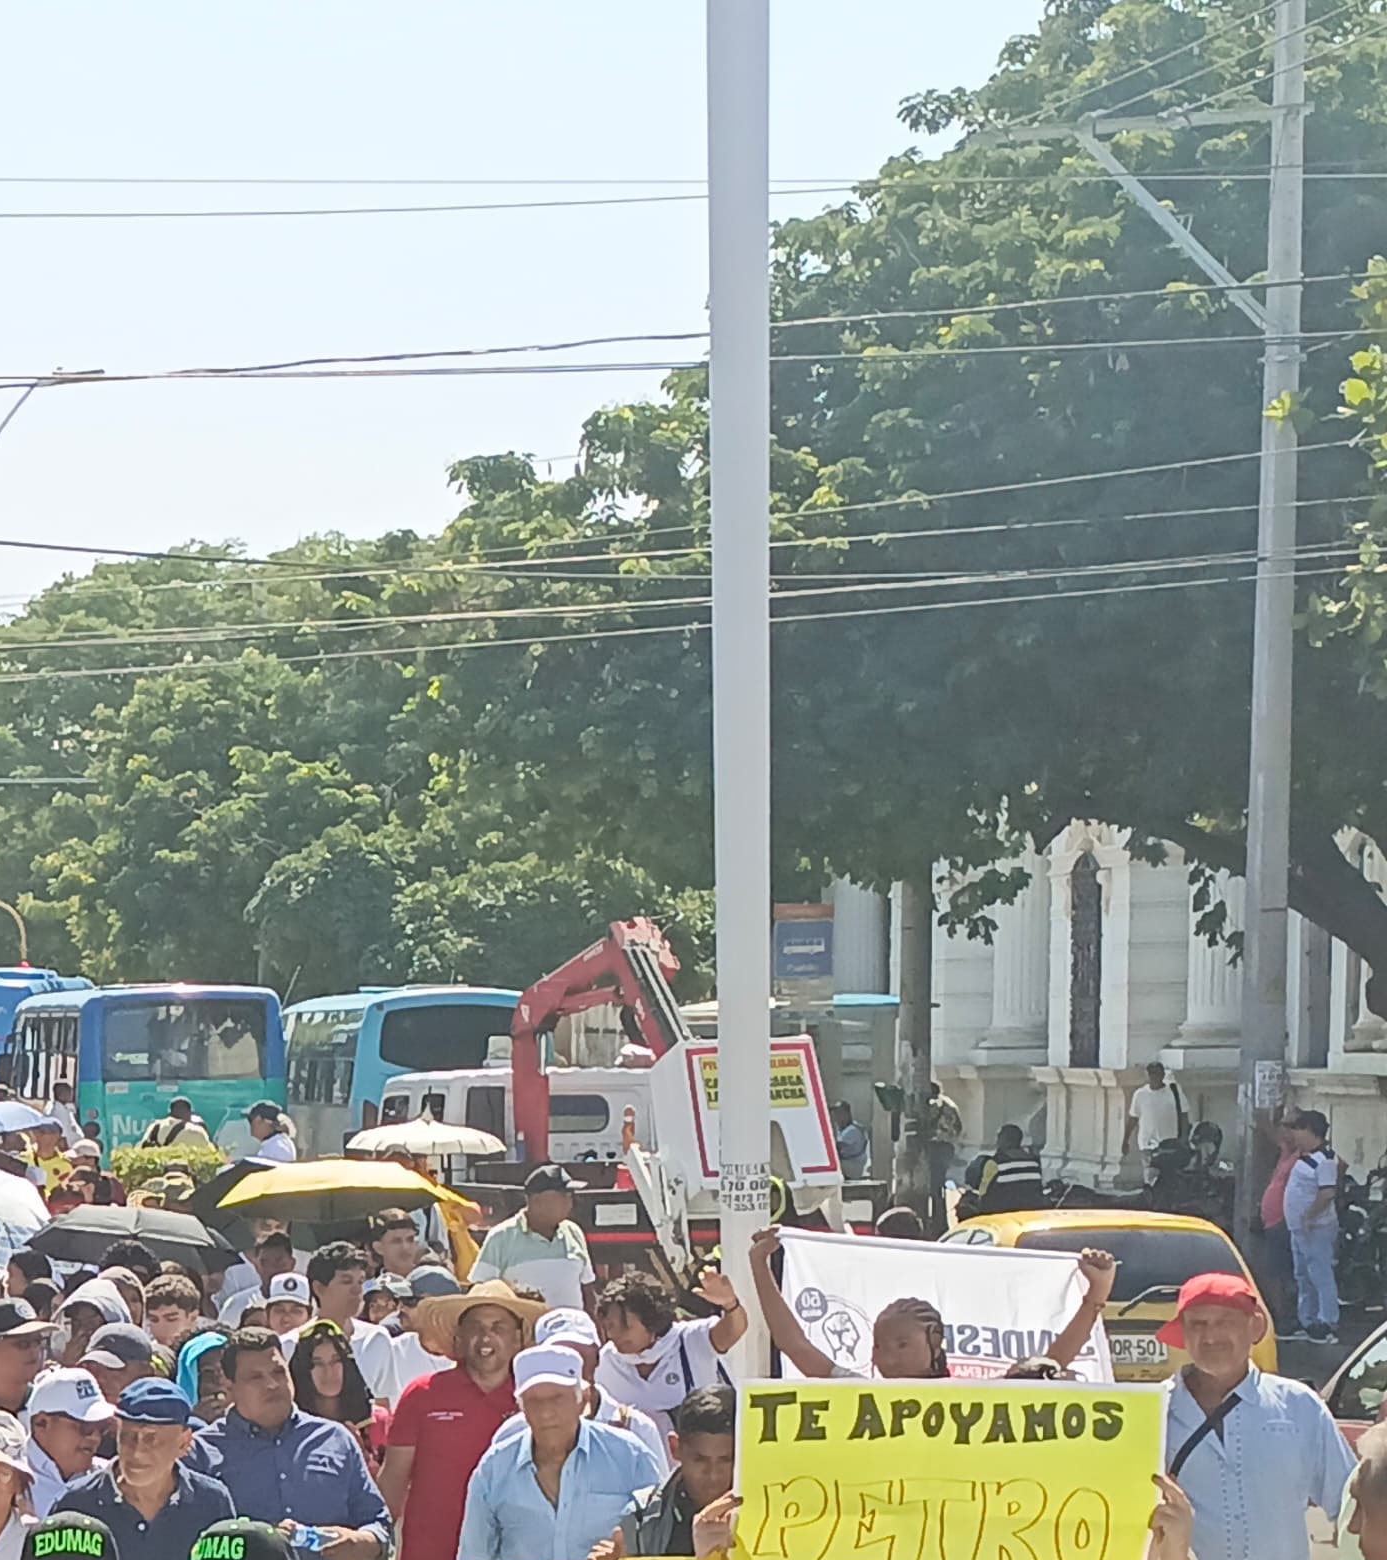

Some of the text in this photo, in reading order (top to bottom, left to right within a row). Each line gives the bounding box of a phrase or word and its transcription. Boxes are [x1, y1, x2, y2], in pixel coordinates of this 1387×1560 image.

[112, 1114, 145, 1135] Nu
[749, 1390, 1124, 1445] TE APOYAMOS
[34, 1528, 103, 1557] EDUMAG
